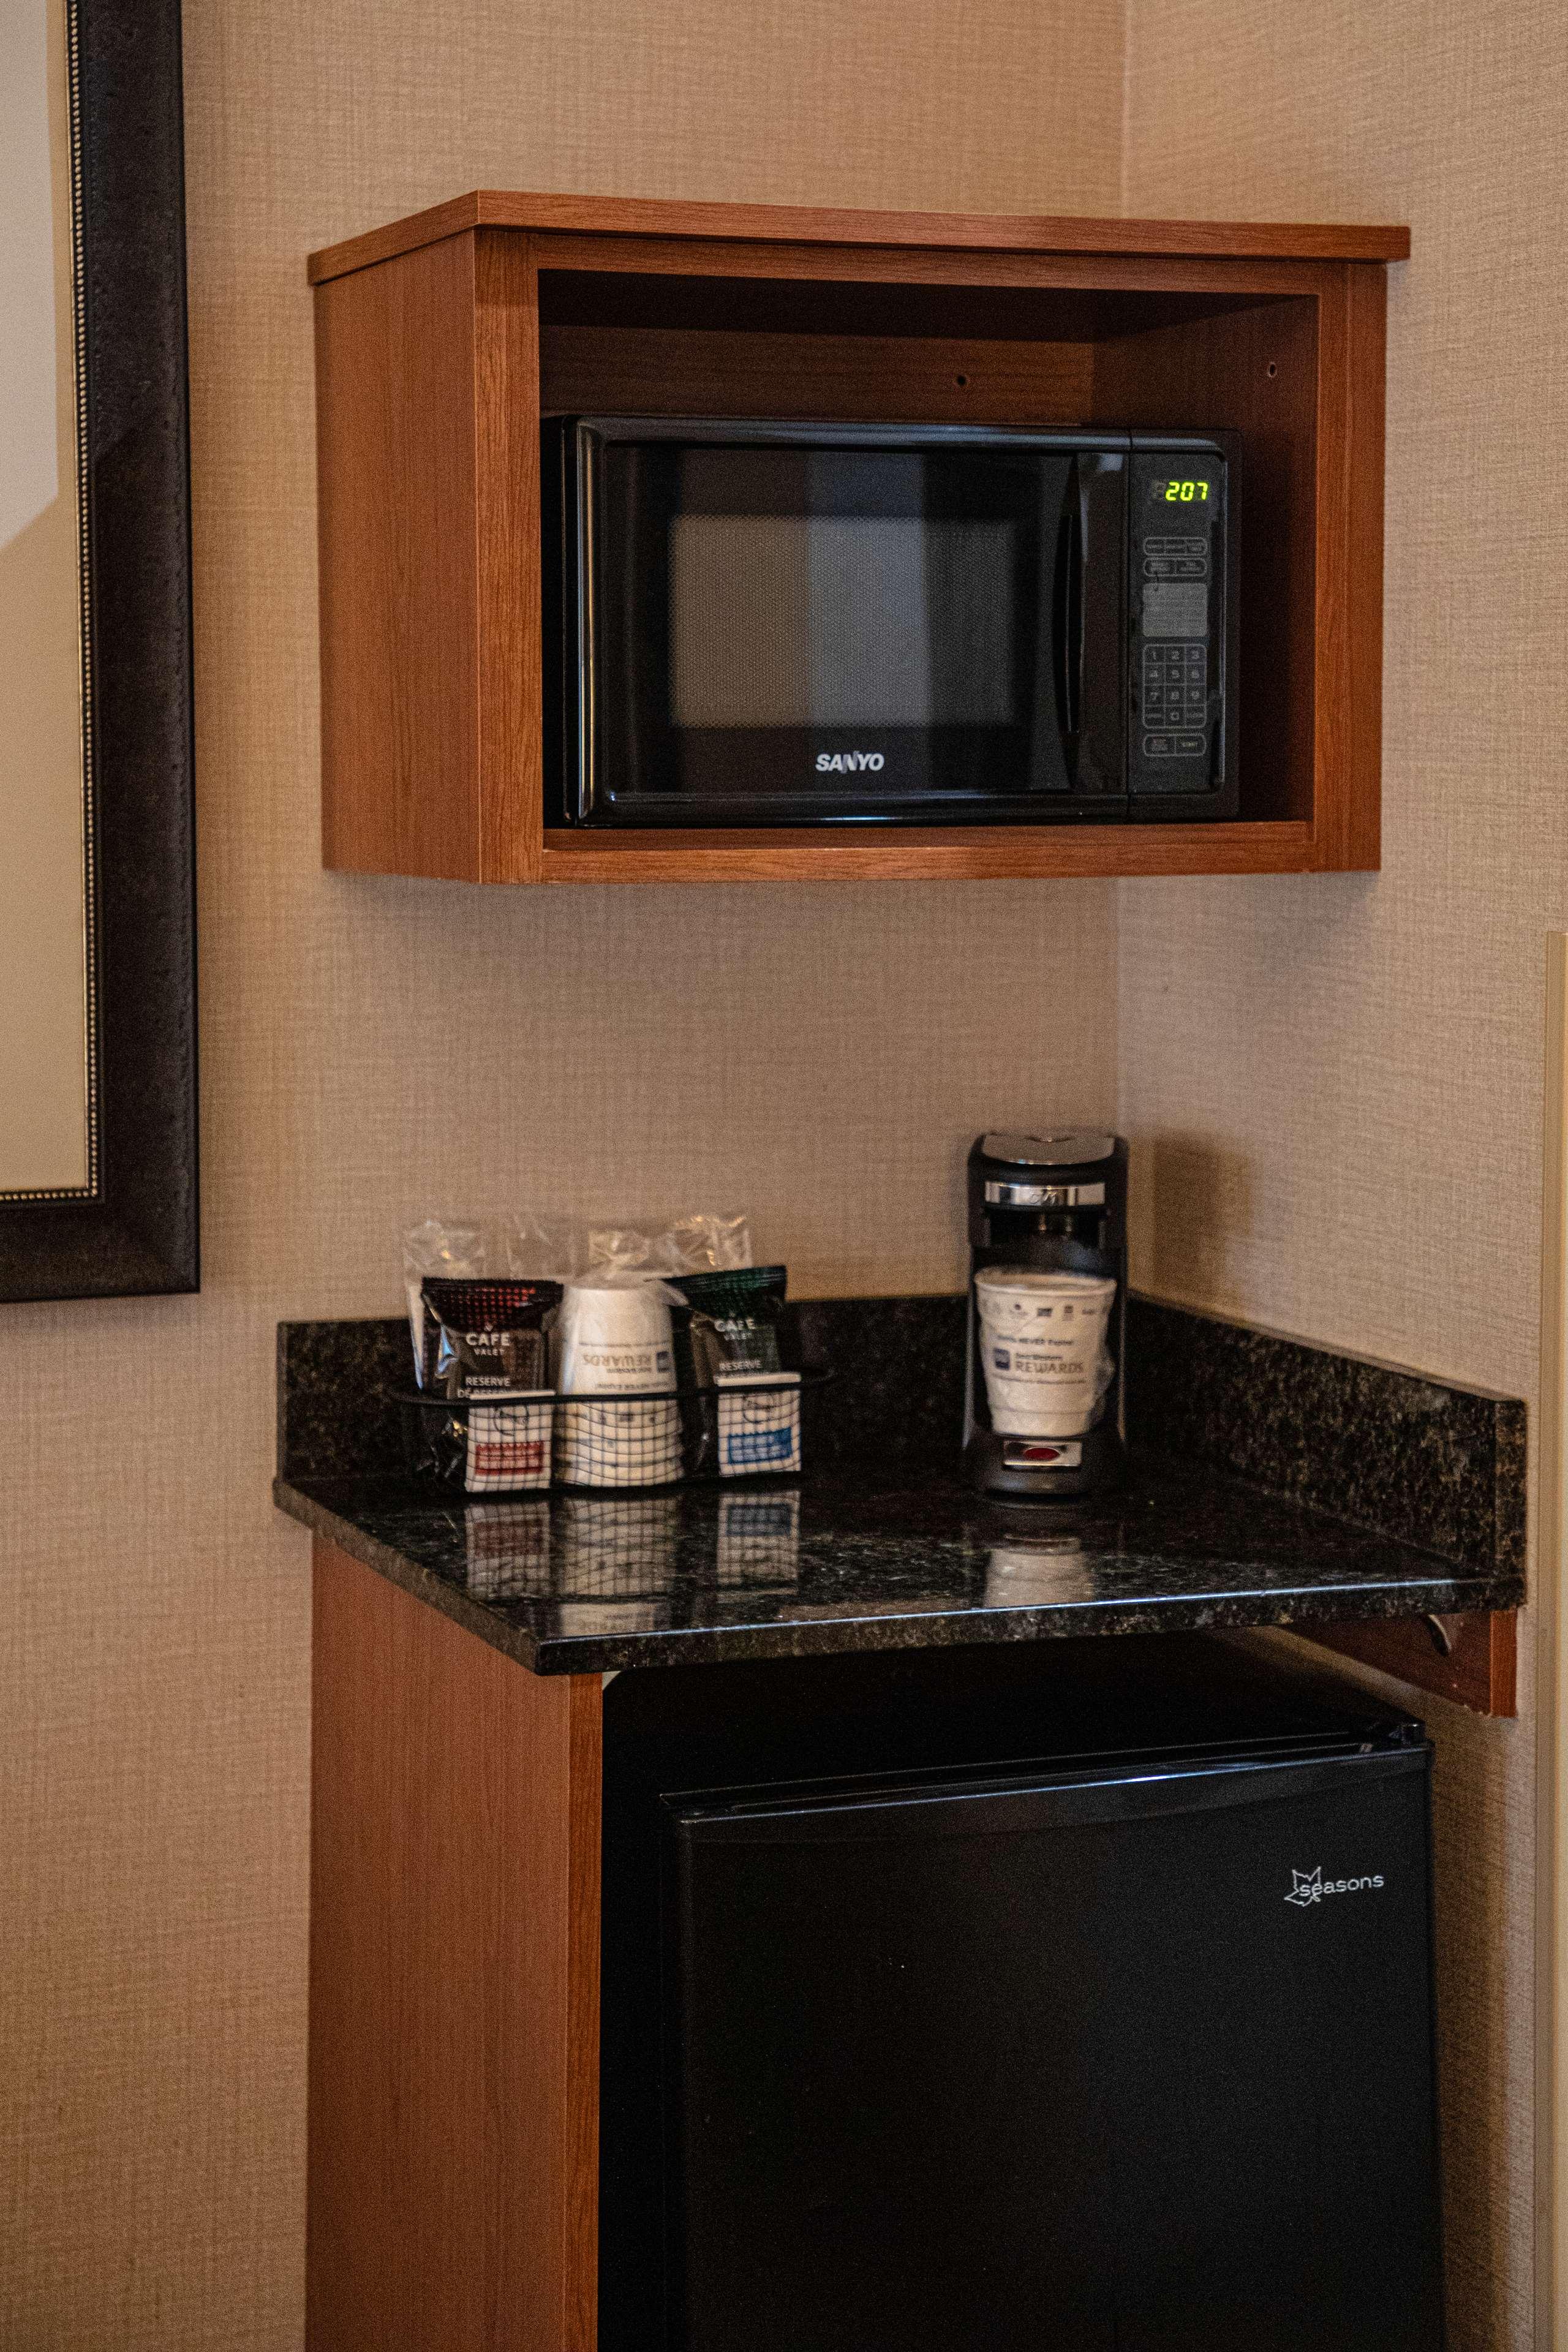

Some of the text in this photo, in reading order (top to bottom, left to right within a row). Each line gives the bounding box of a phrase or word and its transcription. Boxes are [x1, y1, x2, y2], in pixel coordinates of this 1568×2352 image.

[1165, 481, 1208, 501] 207
[1171, 650, 1180, 660] 2
[815, 750, 885, 773] SANYO
[582, 1354, 652, 1366] REWARDS
[1015, 1360, 1084, 1374] REWARDS
[465, 1376, 511, 1387] RESERVE
[1298, 1875, 1384, 1896] seasons
